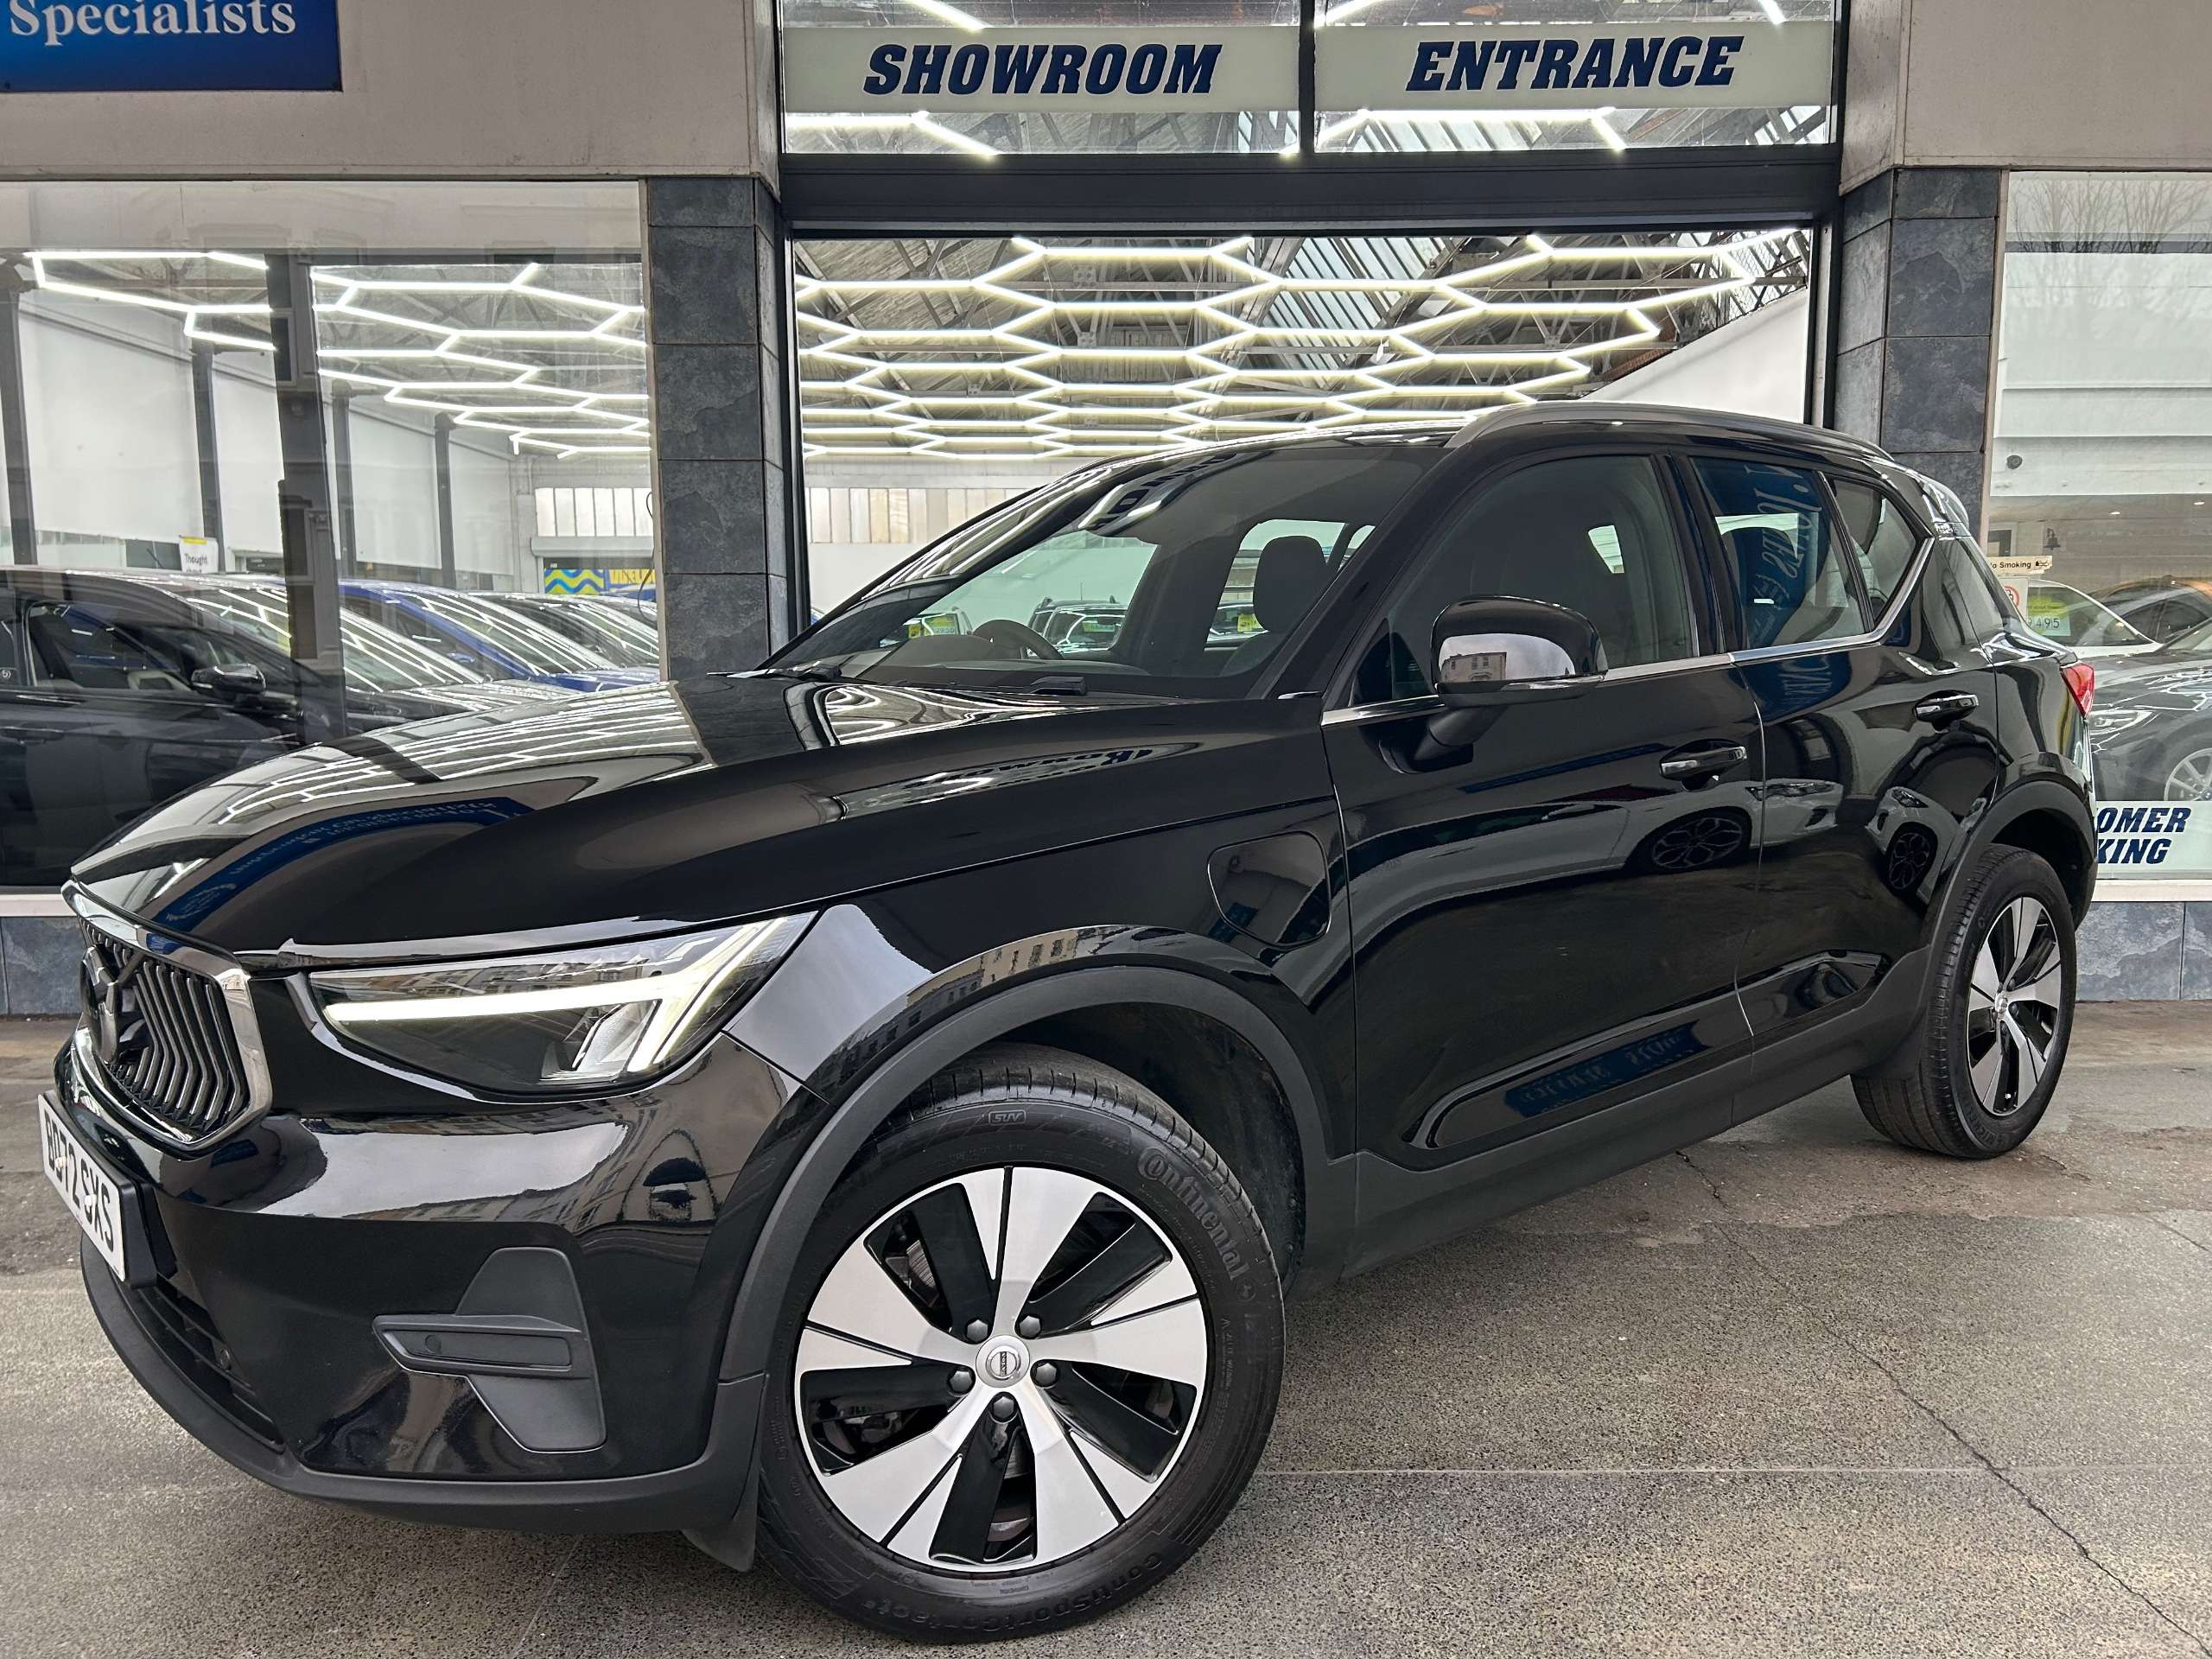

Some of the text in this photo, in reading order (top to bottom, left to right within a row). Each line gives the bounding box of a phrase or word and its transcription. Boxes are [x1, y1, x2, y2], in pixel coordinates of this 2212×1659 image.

[10, 0, 297, 46] Specialists
[863, 36, 1745, 94] SHOWROOM ENTRANCE
[2096, 807, 2192, 834] OMER
[994, 1112, 1023, 1123] SUV
[44, 1109, 80, 1210] BD72
[1137, 1146, 1250, 1281] Continental
